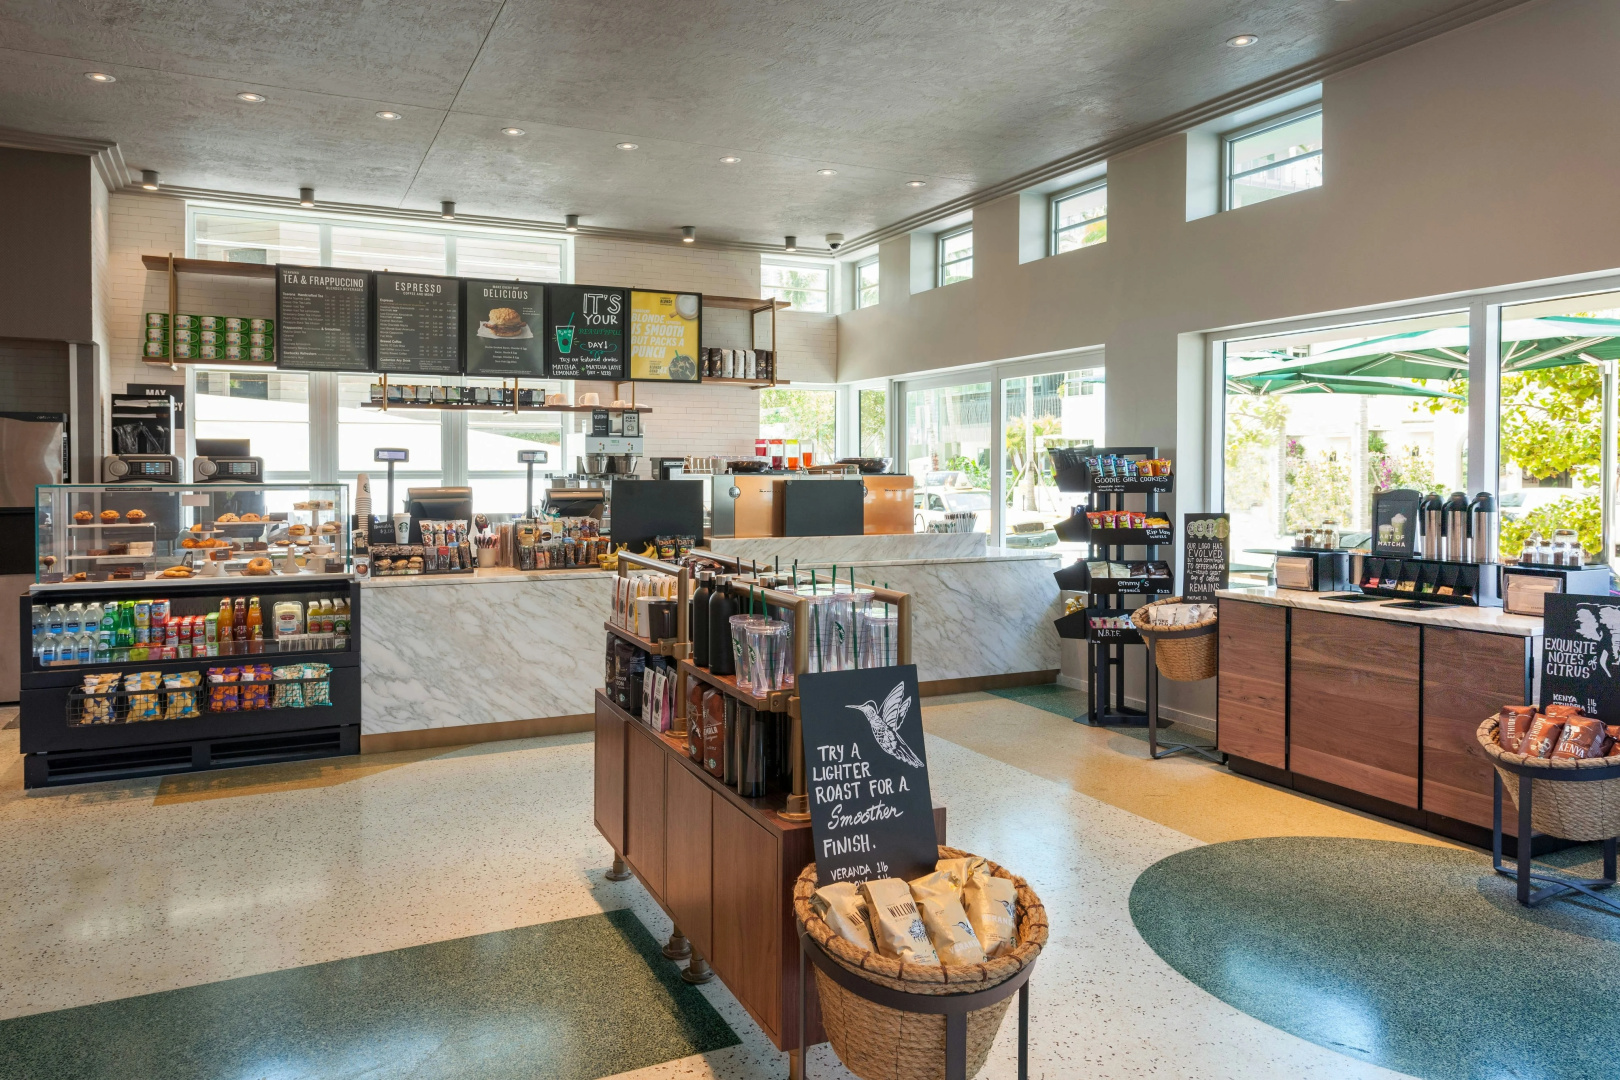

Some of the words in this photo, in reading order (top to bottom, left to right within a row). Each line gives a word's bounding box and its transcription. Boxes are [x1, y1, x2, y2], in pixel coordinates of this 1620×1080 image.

[283, 274, 298, 284] TEA
[301, 275, 307, 284] &
[310, 276, 364, 288] FRAPPUCCINO
[395, 282, 442, 293] ESPRESSO
[484, 288, 528, 299] DELICIOUS
[583, 293, 622, 314] IT'S
[583, 314, 618, 325] YOUR
[631, 313, 666, 324] BLONDE
[631, 323, 642, 334] IS
[644, 324, 684, 337] SMOOTH
[631, 336, 648, 344] BUT
[650, 337, 676, 347] PACKS
[678, 338, 684, 347] A
[631, 346, 666, 358] PUNCH
[1189, 583, 1220, 592] REMAINS
[1545, 638, 1597, 655] EXQUISITE
[1548, 652, 1584, 665] NOTES
[1546, 663, 1590, 679] CITRUS
[1553, 694, 1578, 703] KENYA
[1507, 711, 1516, 739] ETHIOPIA
[1529, 718, 1546, 740] ETHIOPIA
[817, 745, 844, 762] TRY
[851, 743, 861, 759] A
[1558, 743, 1585, 758] KENYA
[813, 762, 871, 782] LIGHTER
[816, 782, 860, 804] ROAST
[870, 778, 894, 797] FOR
[899, 776, 910, 792] A
[828, 800, 904, 830] Smoother
[823, 834, 876, 858] FINISH.
[830, 864, 872, 881] VERANDA
[887, 902, 916, 918] WILLOW
